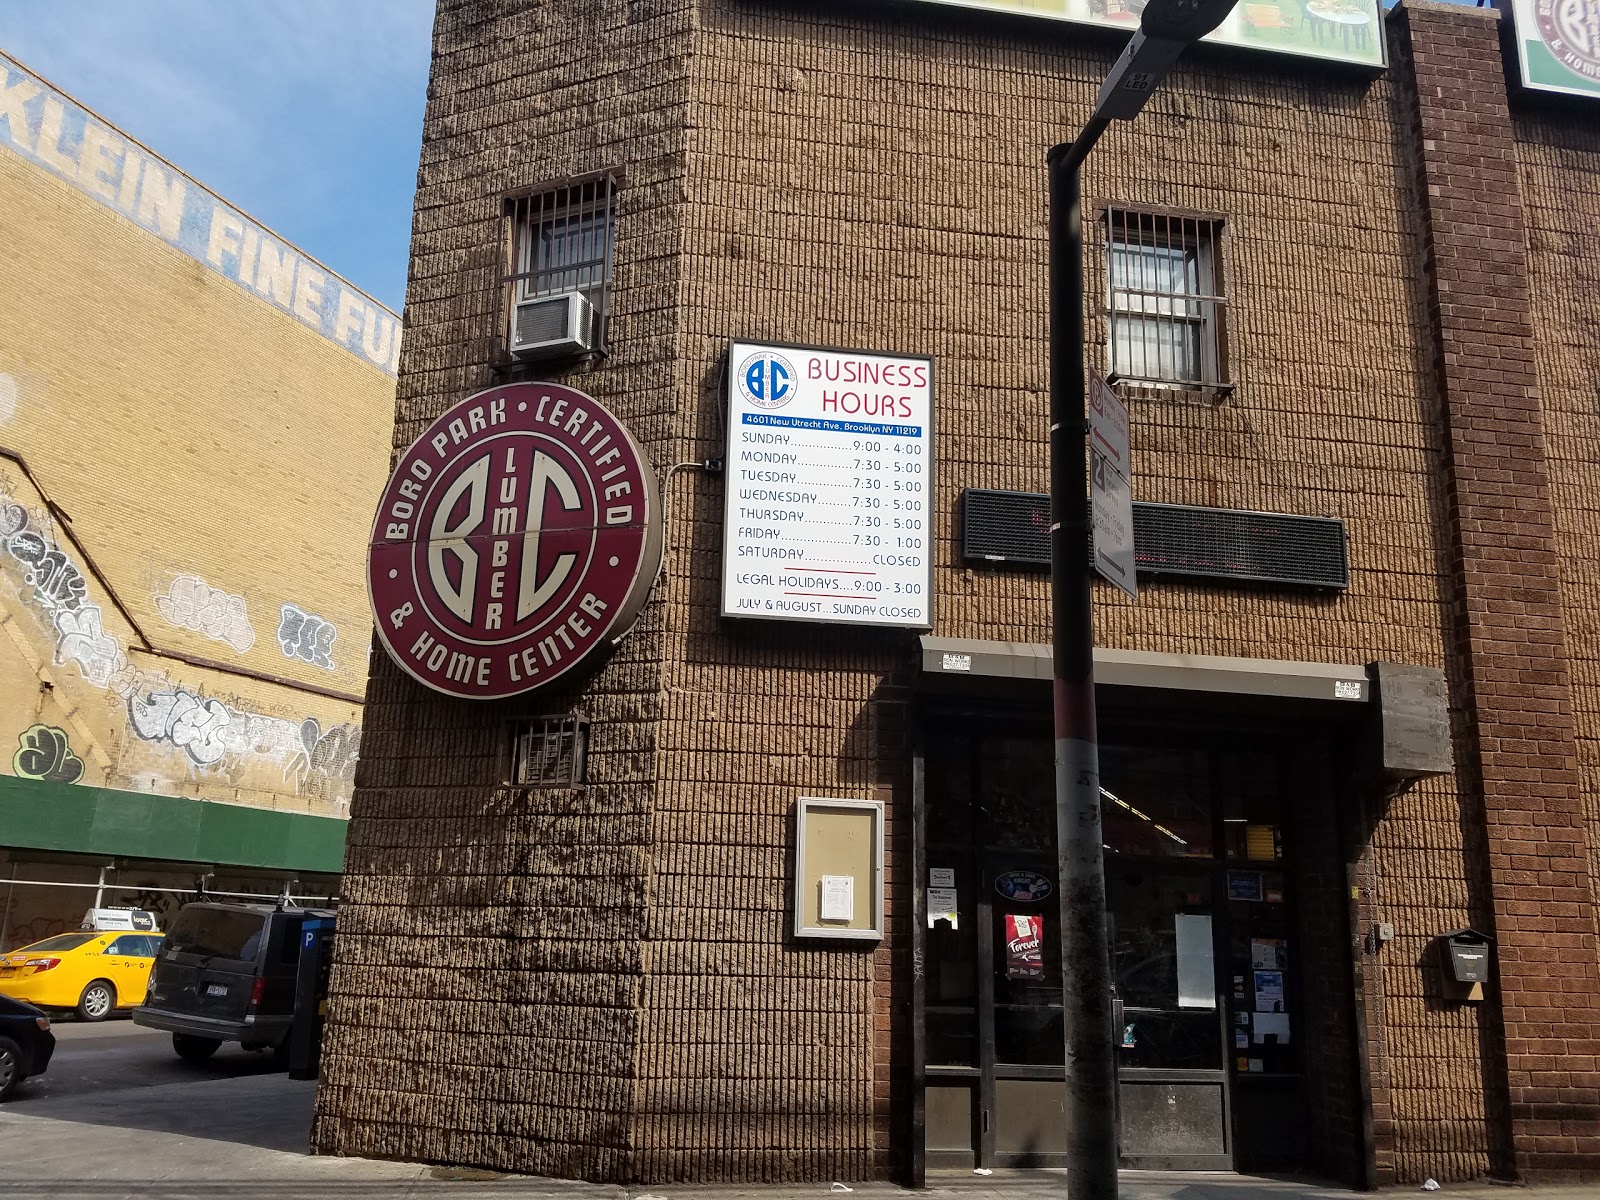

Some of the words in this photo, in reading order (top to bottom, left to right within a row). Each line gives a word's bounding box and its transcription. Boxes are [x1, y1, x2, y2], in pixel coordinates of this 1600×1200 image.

[1133, 73, 1148, 81] 91
[1125, 81, 1148, 89] LED
[0, 66, 187, 242] KLEIN
[206, 206, 325, 330] FINE
[808, 357, 927, 388] BUSINESS
[822, 390, 912, 418] HOURS
[747, 415, 769, 425] 4601
[770, 417, 789, 426] New
[791, 418, 821, 429] Utrecht
[823, 421, 842, 430] Ave.
[844, 422, 880, 434] Brooklyn
[882, 425, 894, 434] NY
[896, 426, 918, 436] 11219
[893, 443, 921, 455] 4:00
[535, 396, 633, 525] CERTIFIED
[894, 462, 921, 473] 5:00
[386, 458, 433, 540] BORO
[431, 398, 507, 459] PARK
[893, 481, 921, 492] 5:00
[893, 500, 921, 511] 5:00
[893, 519, 921, 530] 5:00
[485, 447, 517, 630] LUMBER
[896, 537, 921, 549] 1:00
[873, 555, 921, 567] CLOSED
[736, 573, 775, 586] LEGAL
[894, 582, 921, 594] 3:00
[736, 598, 761, 609] JULY
[765, 600, 773, 610] &
[879, 606, 922, 619] CLOSED
[390, 601, 415, 630] &
[410, 630, 492, 686] HOME
[508, 592, 608, 682] CENTER
[306, 932, 314, 947] P
[1007, 938, 1039, 953] Forever
